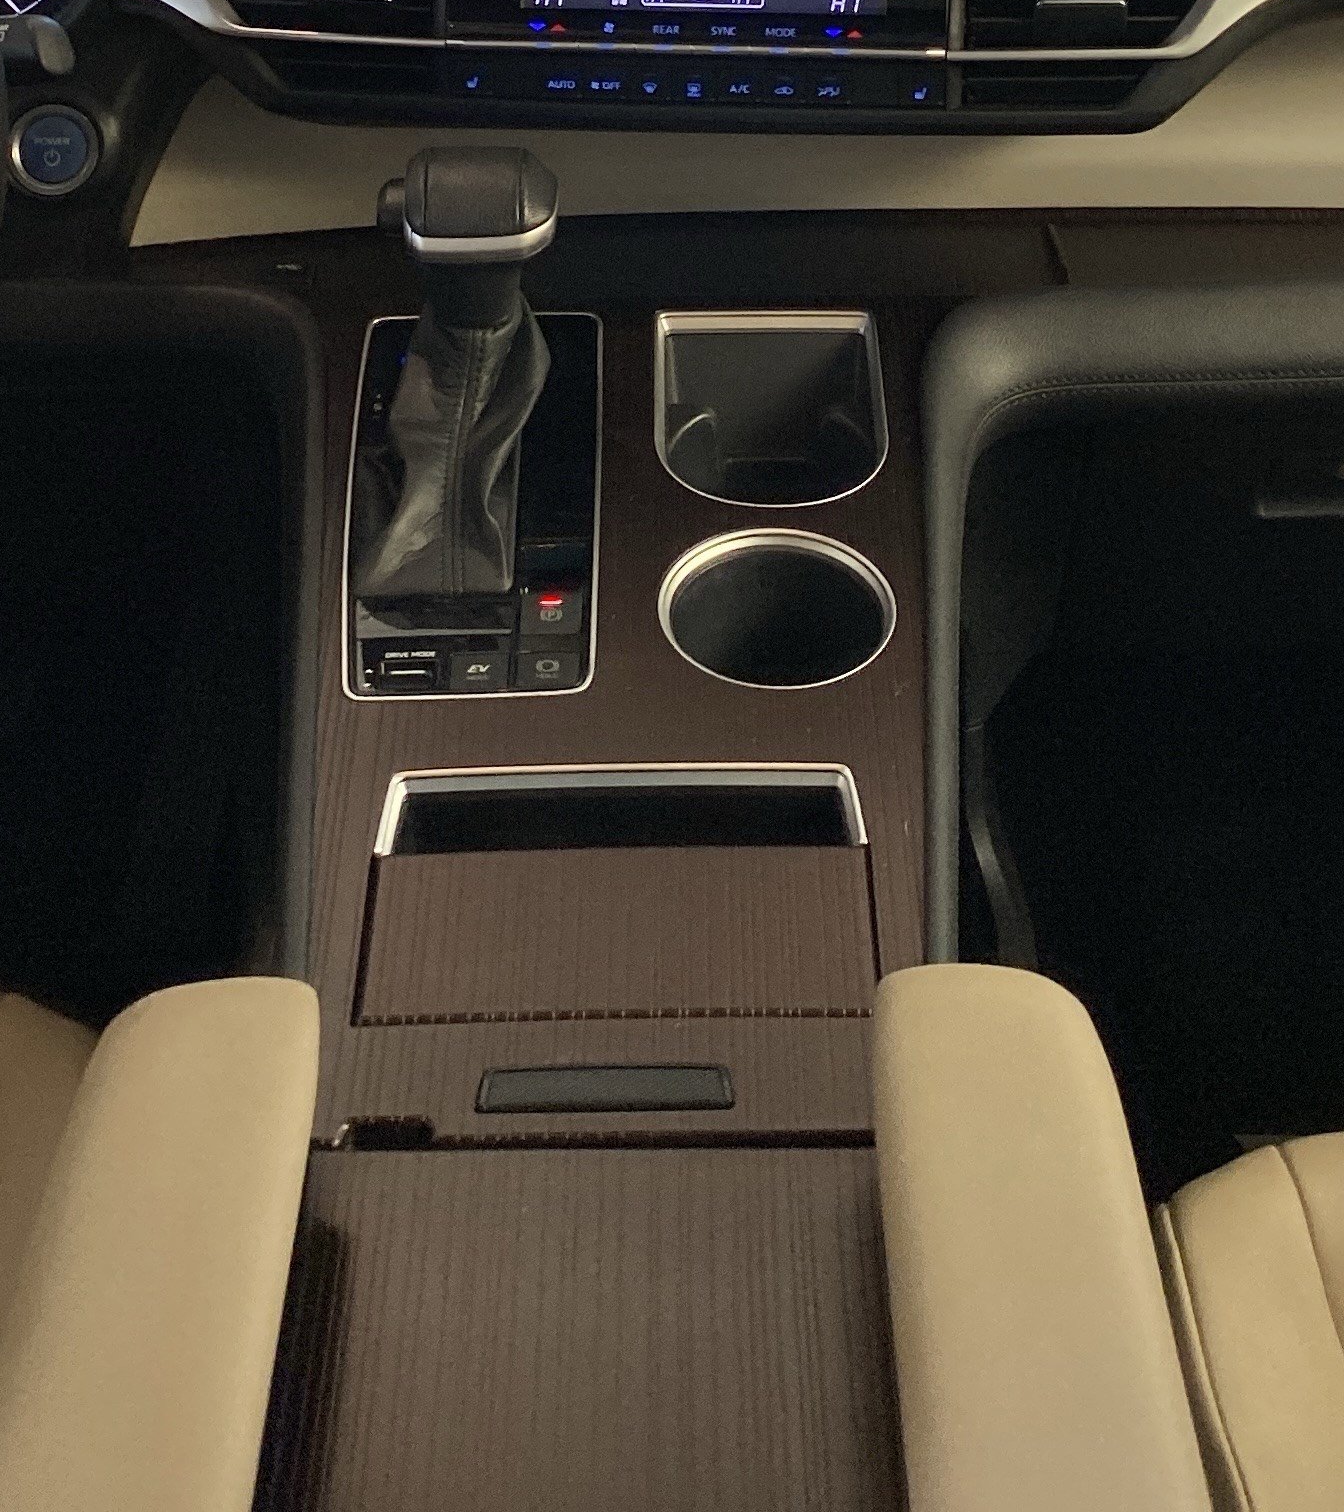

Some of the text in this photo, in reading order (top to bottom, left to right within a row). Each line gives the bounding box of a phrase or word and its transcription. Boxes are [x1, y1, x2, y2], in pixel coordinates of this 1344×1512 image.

[652, 25, 680, 35] REAR
[711, 26, 737, 36] SYNC
[765, 27, 796, 37] MODE
[547, 80, 576, 89] AUTO
[602, 81, 621, 90] OFF
[729, 84, 750, 94] A/C
